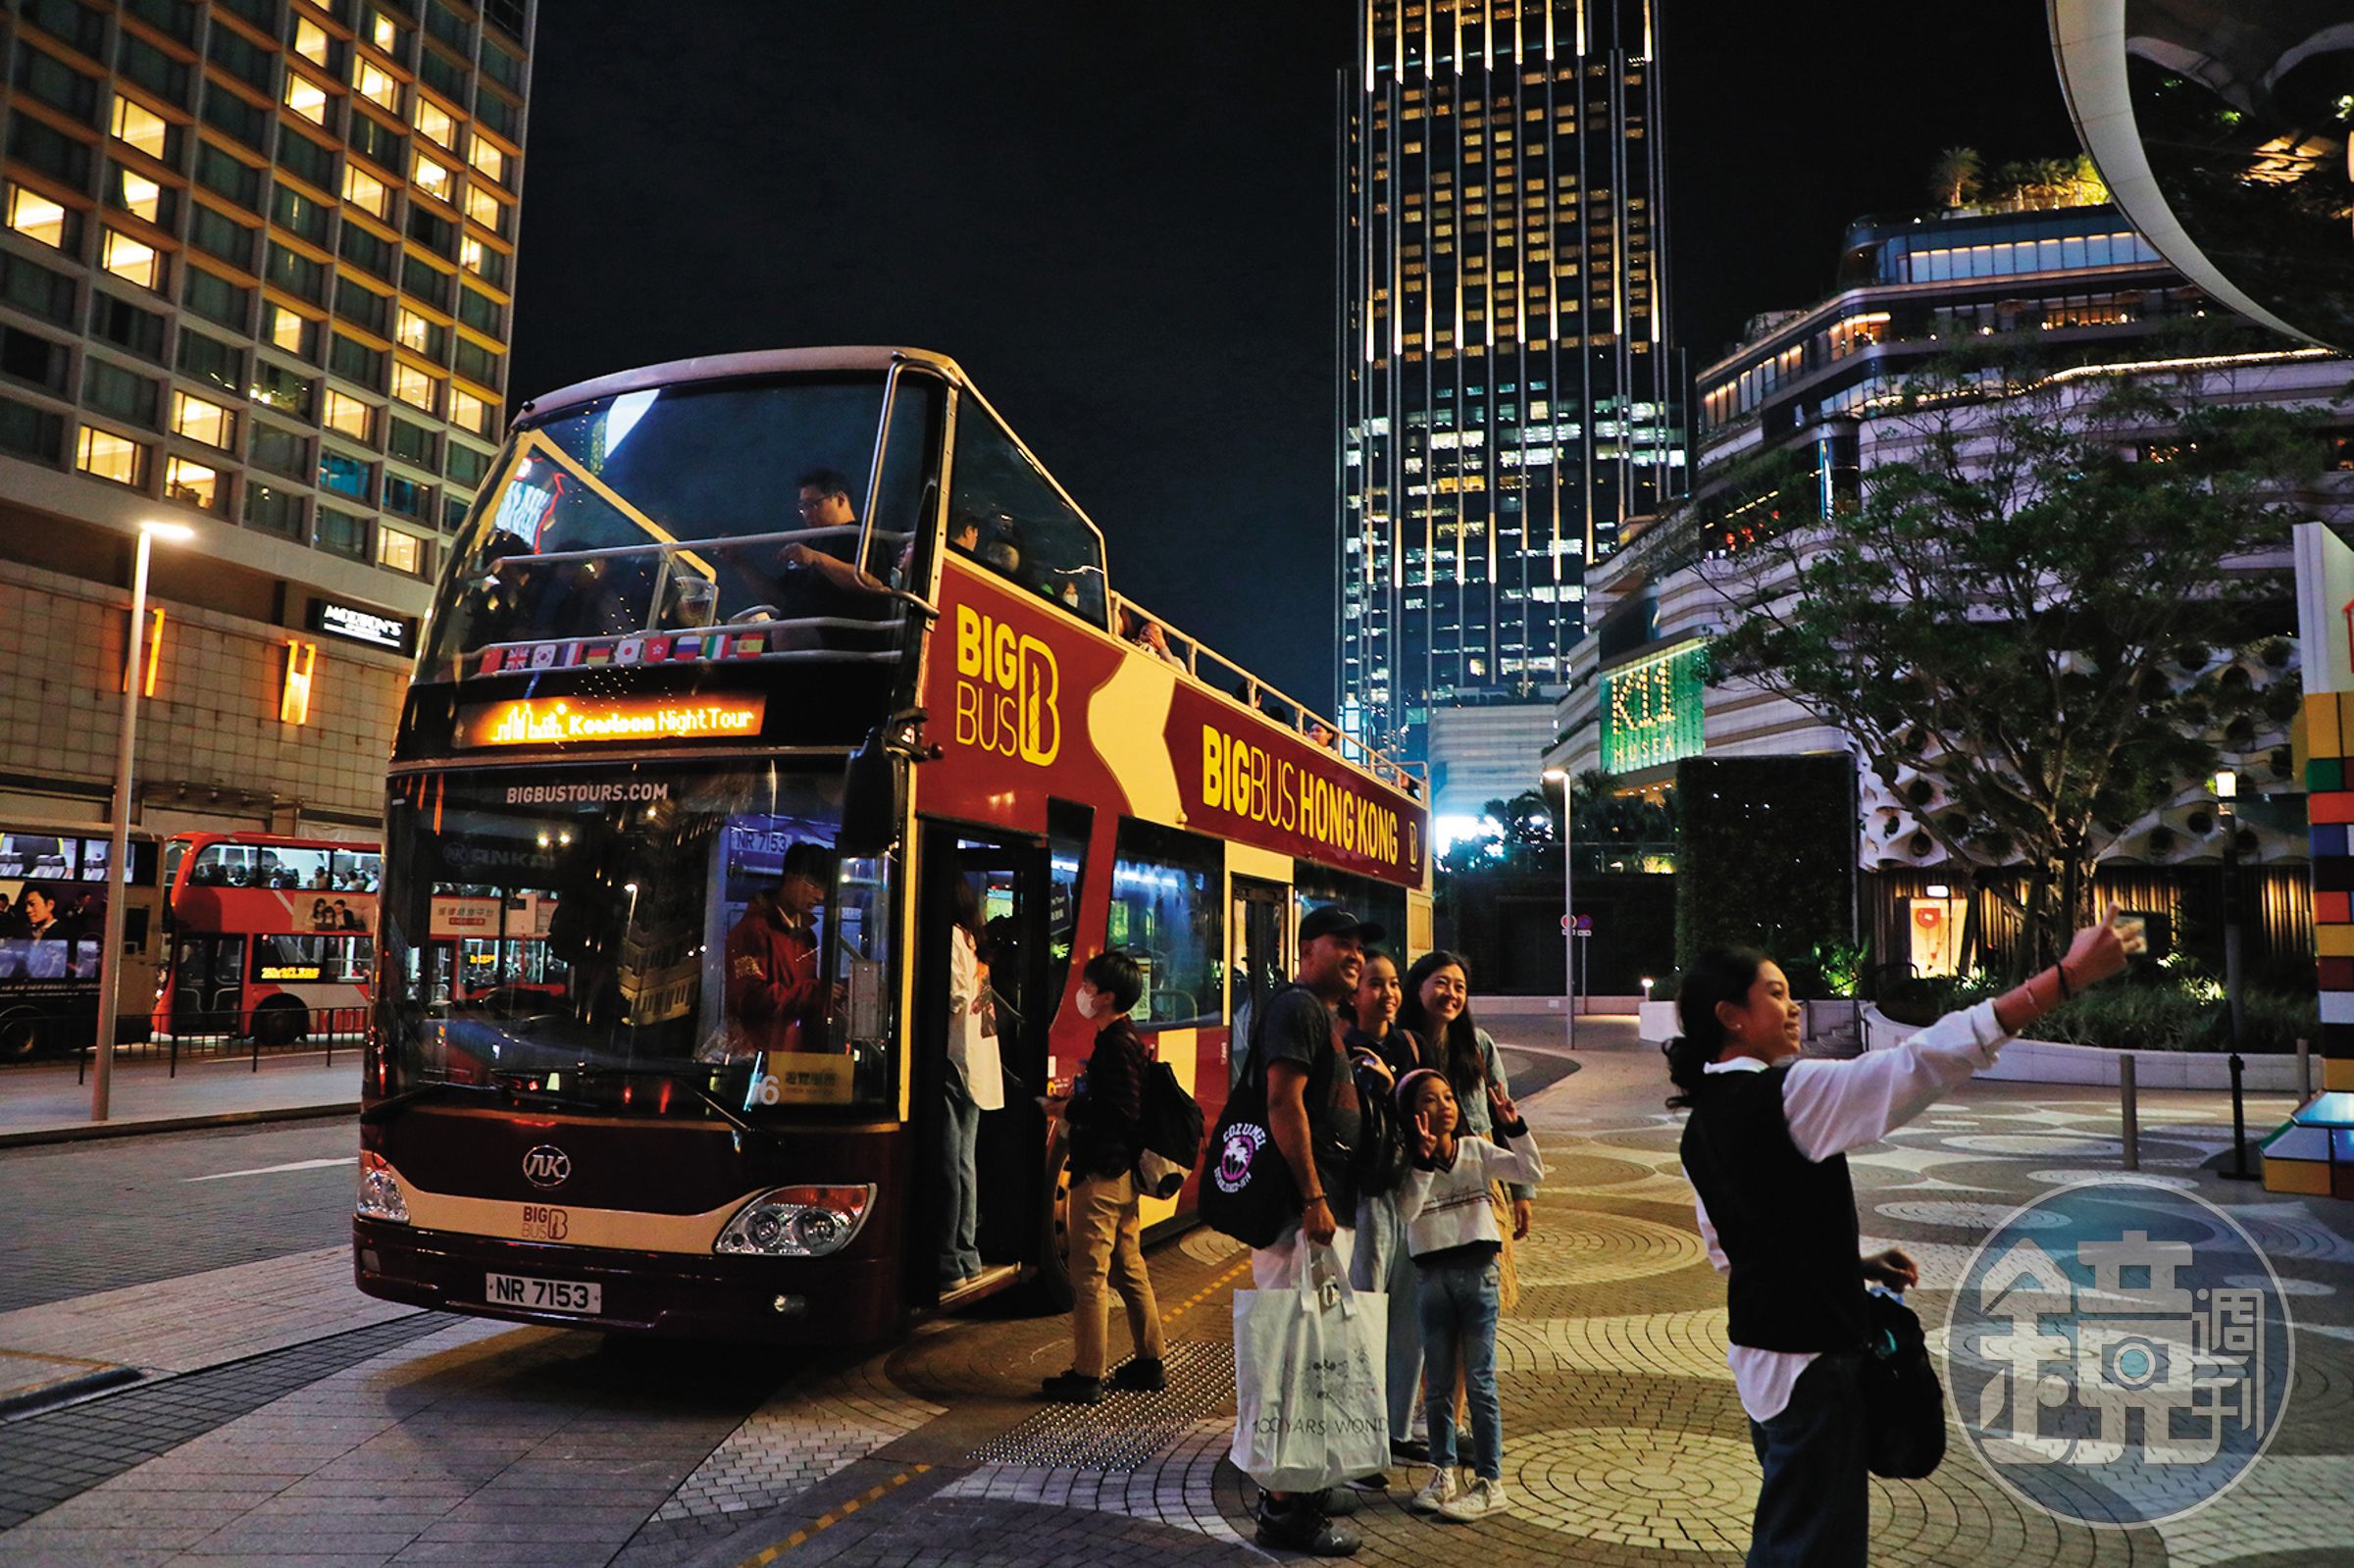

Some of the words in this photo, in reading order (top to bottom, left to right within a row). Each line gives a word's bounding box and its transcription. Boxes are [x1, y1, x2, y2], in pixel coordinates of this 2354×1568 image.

[957, 603, 1017, 690] BIG
[1612, 659, 1676, 735] K11
[569, 713, 655, 735] Kowloon
[658, 709, 708, 736] Night
[707, 707, 753, 730] Tour
[956, 681, 1017, 757] BUS
[1613, 734, 1673, 765] MUSEA
[506, 783, 668, 804] BIGBUSTOURS.COM
[1300, 769, 1354, 851] HONG
[1356, 795, 1399, 866] KONG
[737, 831, 754, 850] NR
[759, 833, 788, 853] 7153
[1223, 1123, 1266, 1150] COZUMEL
[523, 1205, 547, 1223] BIG
[522, 1223, 547, 1239] BUS
[495, 1277, 525, 1303] NR
[532, 1281, 588, 1309] 7153
